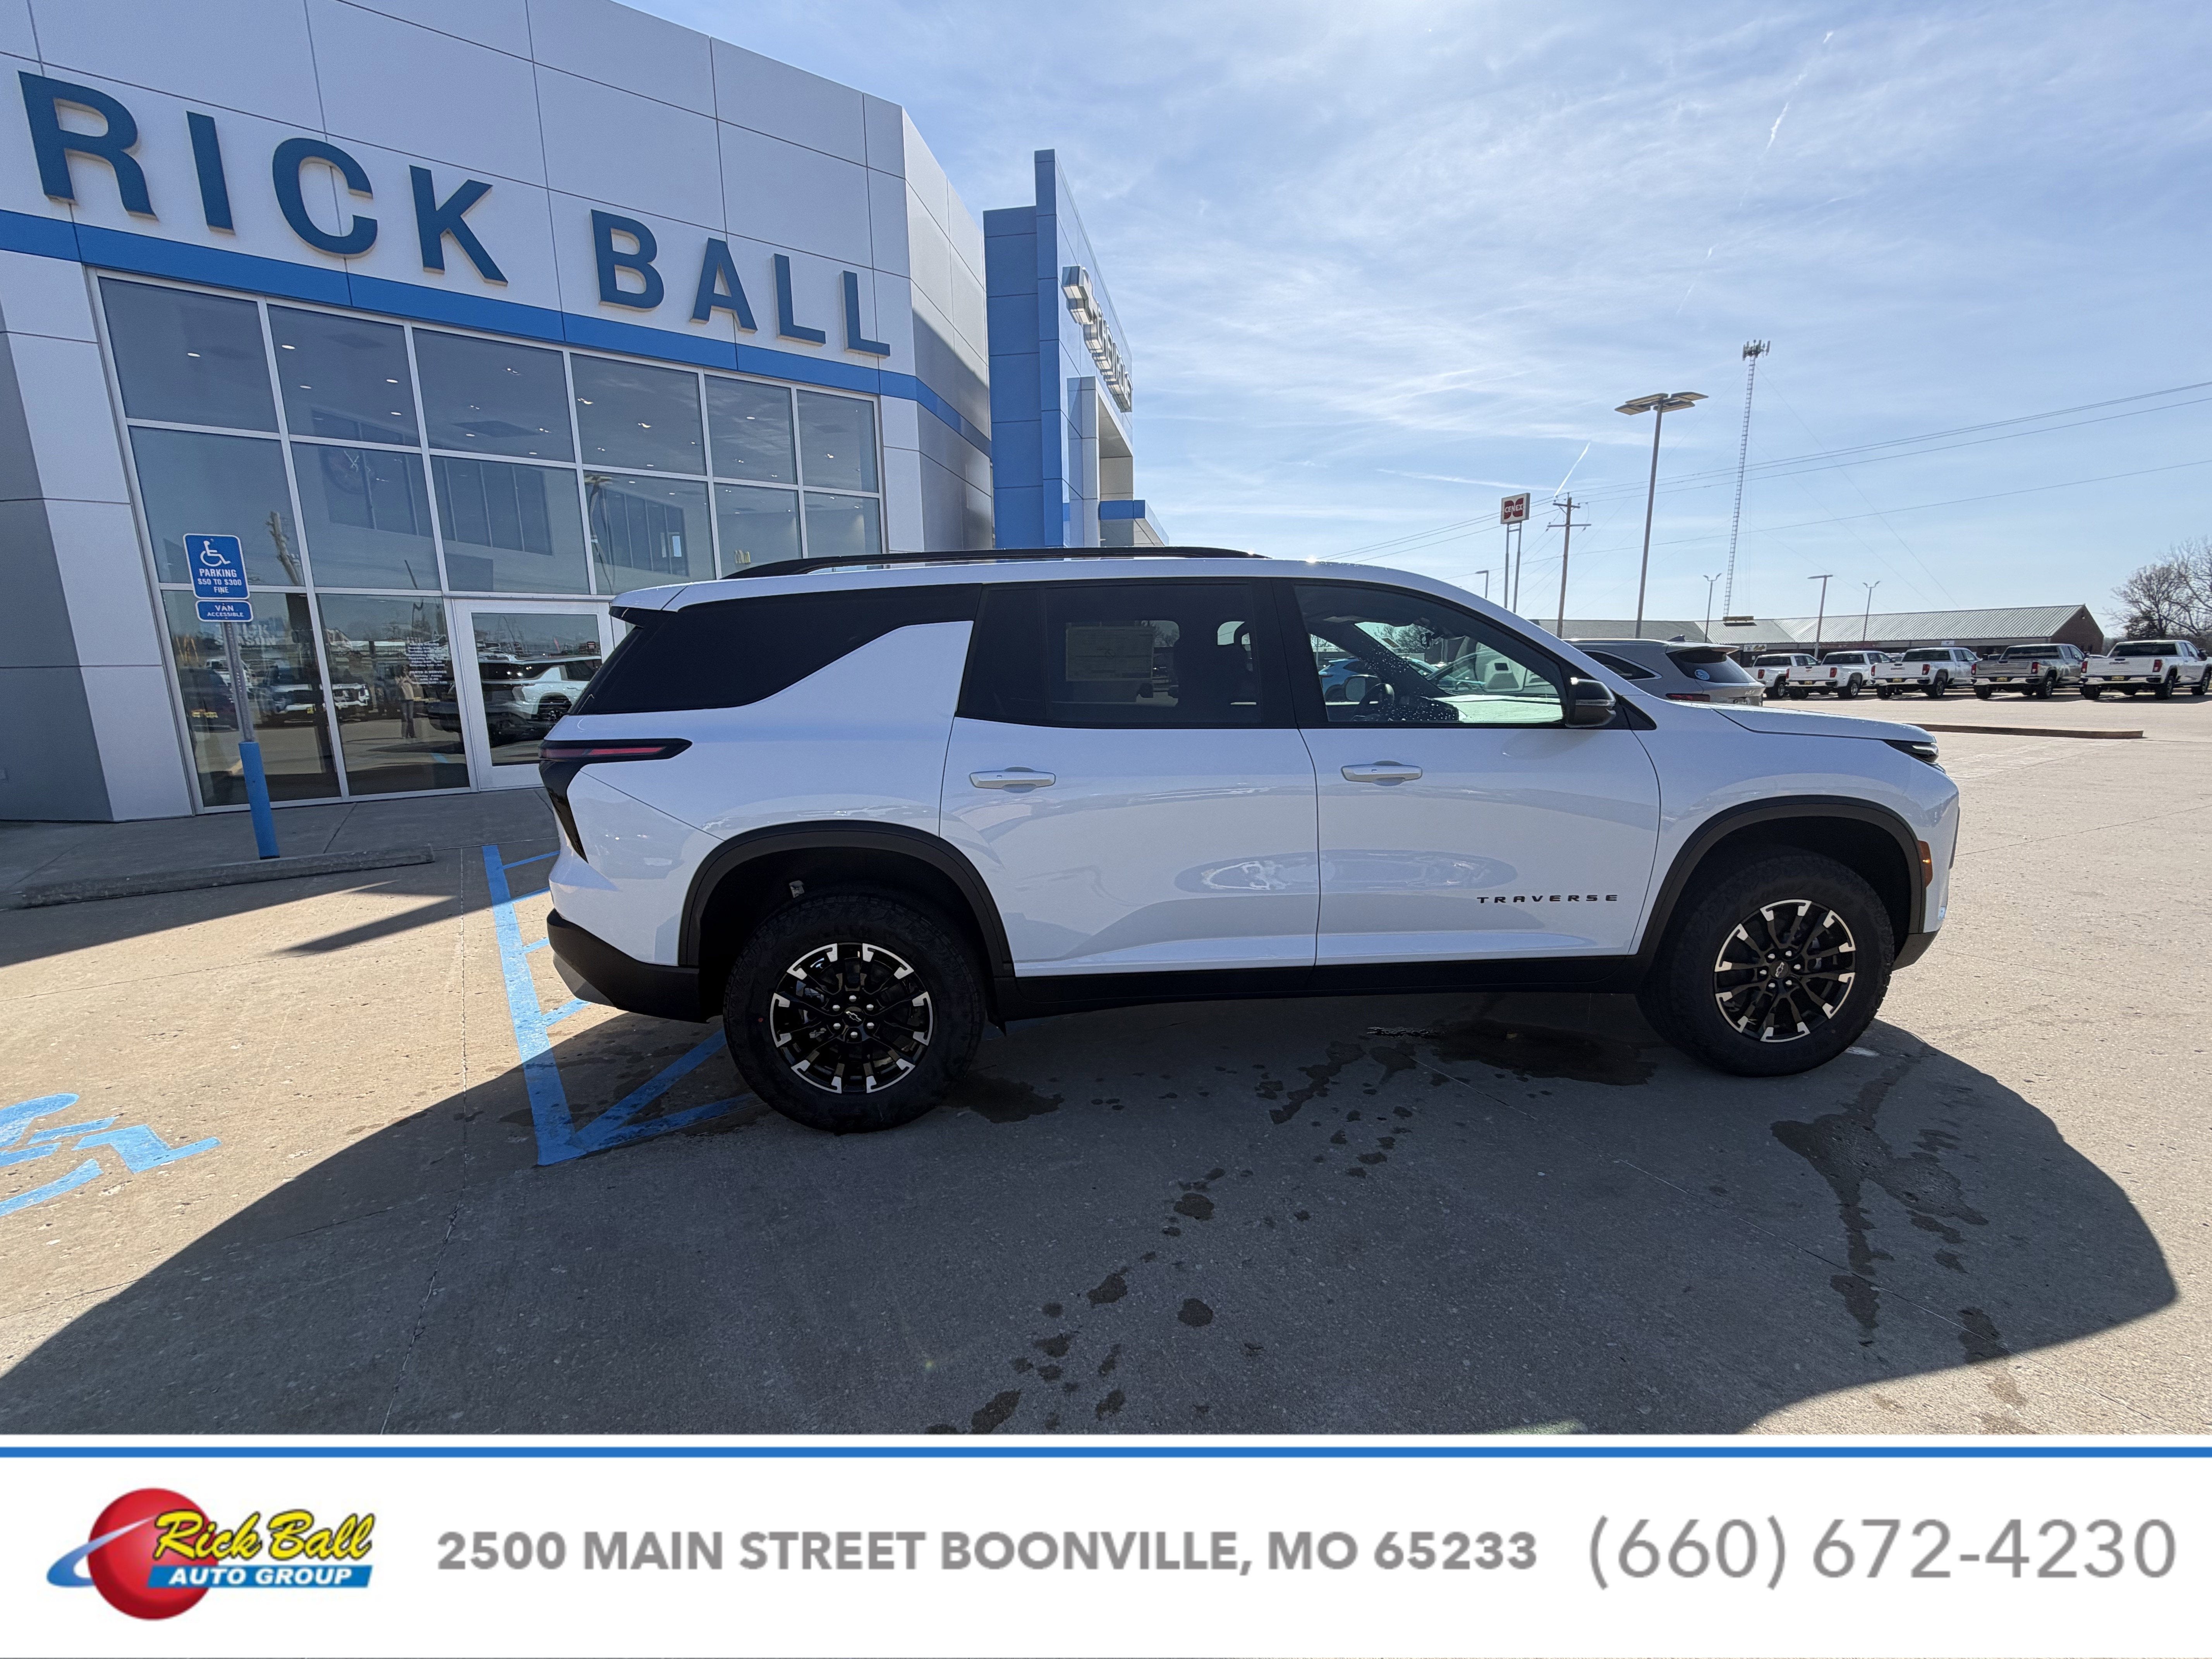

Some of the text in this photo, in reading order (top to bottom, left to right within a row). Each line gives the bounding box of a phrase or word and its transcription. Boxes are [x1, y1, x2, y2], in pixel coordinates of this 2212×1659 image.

[18, 70, 891, 358] RICK BALL
[1505, 504, 1523, 513] CENEX
[199, 568, 237, 577] PARKING
[1477, 895, 1618, 903] TRAVERSE
